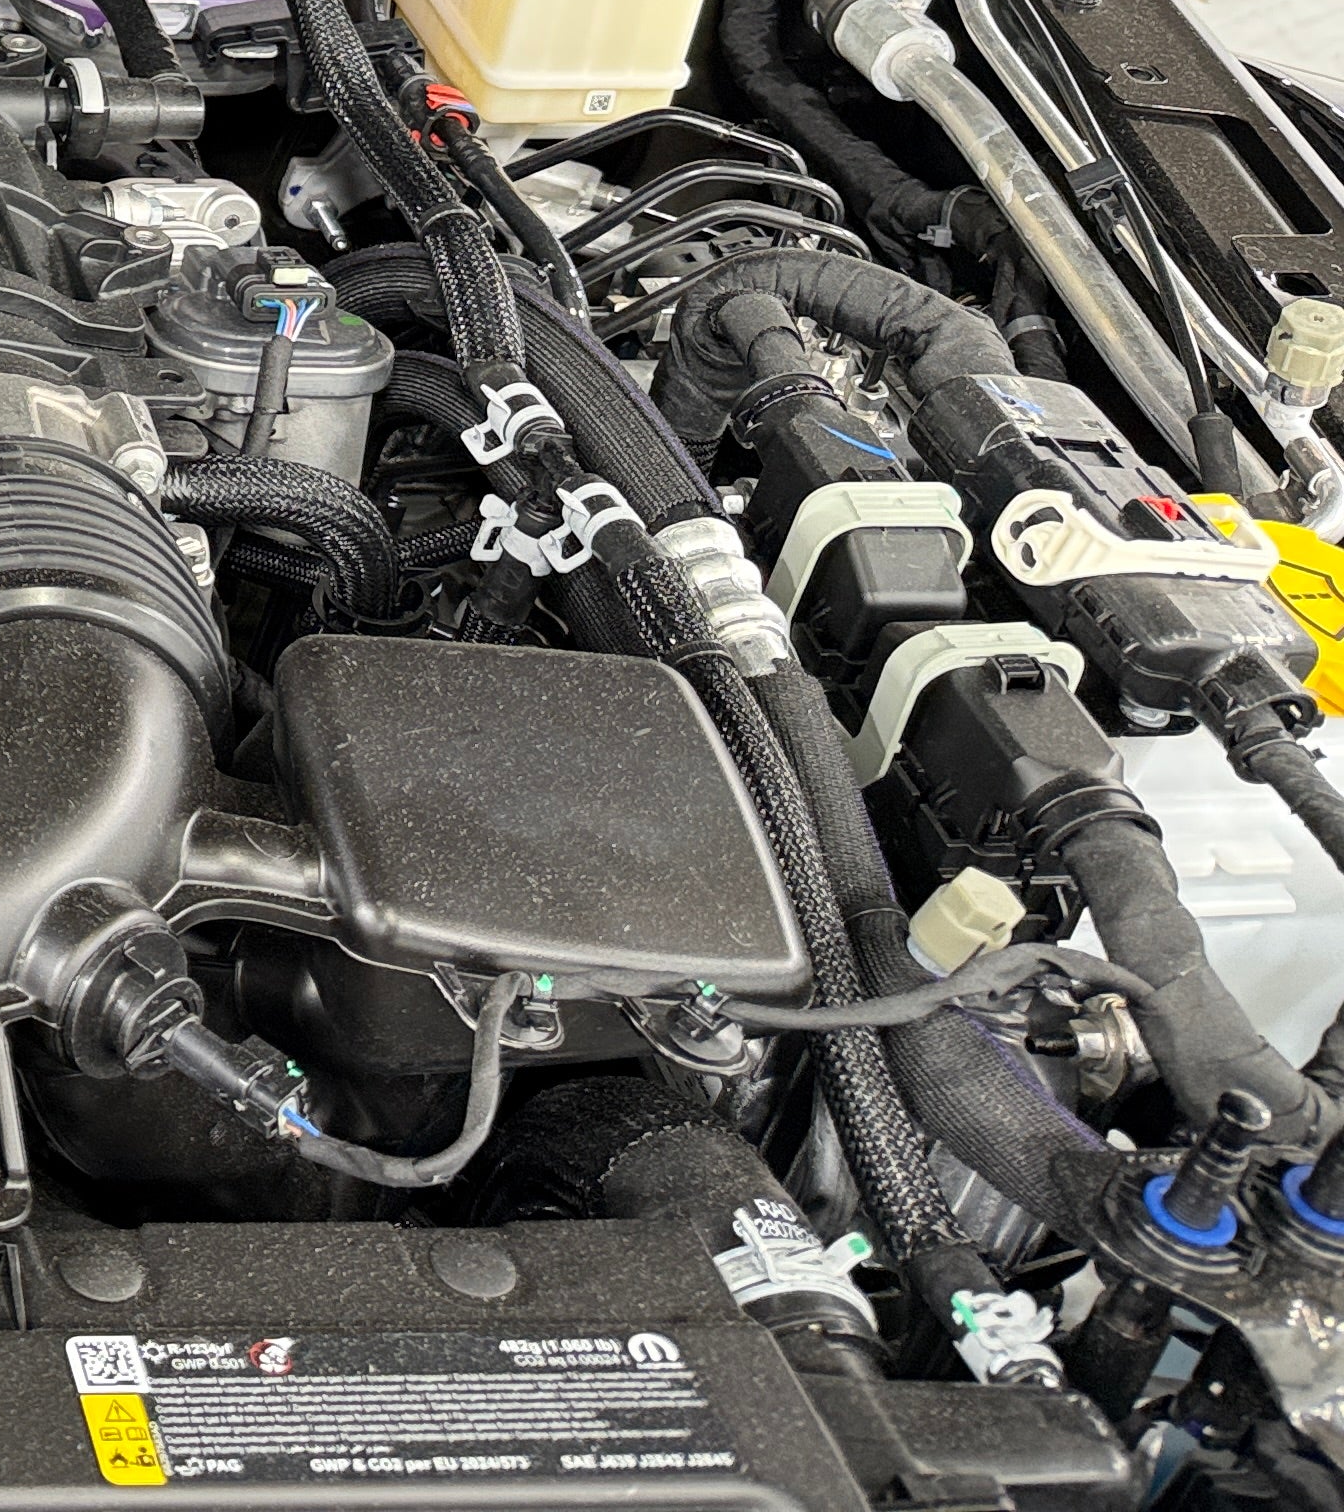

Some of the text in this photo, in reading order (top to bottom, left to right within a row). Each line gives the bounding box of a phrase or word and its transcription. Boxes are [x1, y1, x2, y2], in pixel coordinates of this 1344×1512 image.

[171, 1357, 206, 1370] GWP
[207, 1459, 244, 1473] PAG
[310, 1458, 352, 1473] GWP
[433, 1456, 459, 1472] EU
